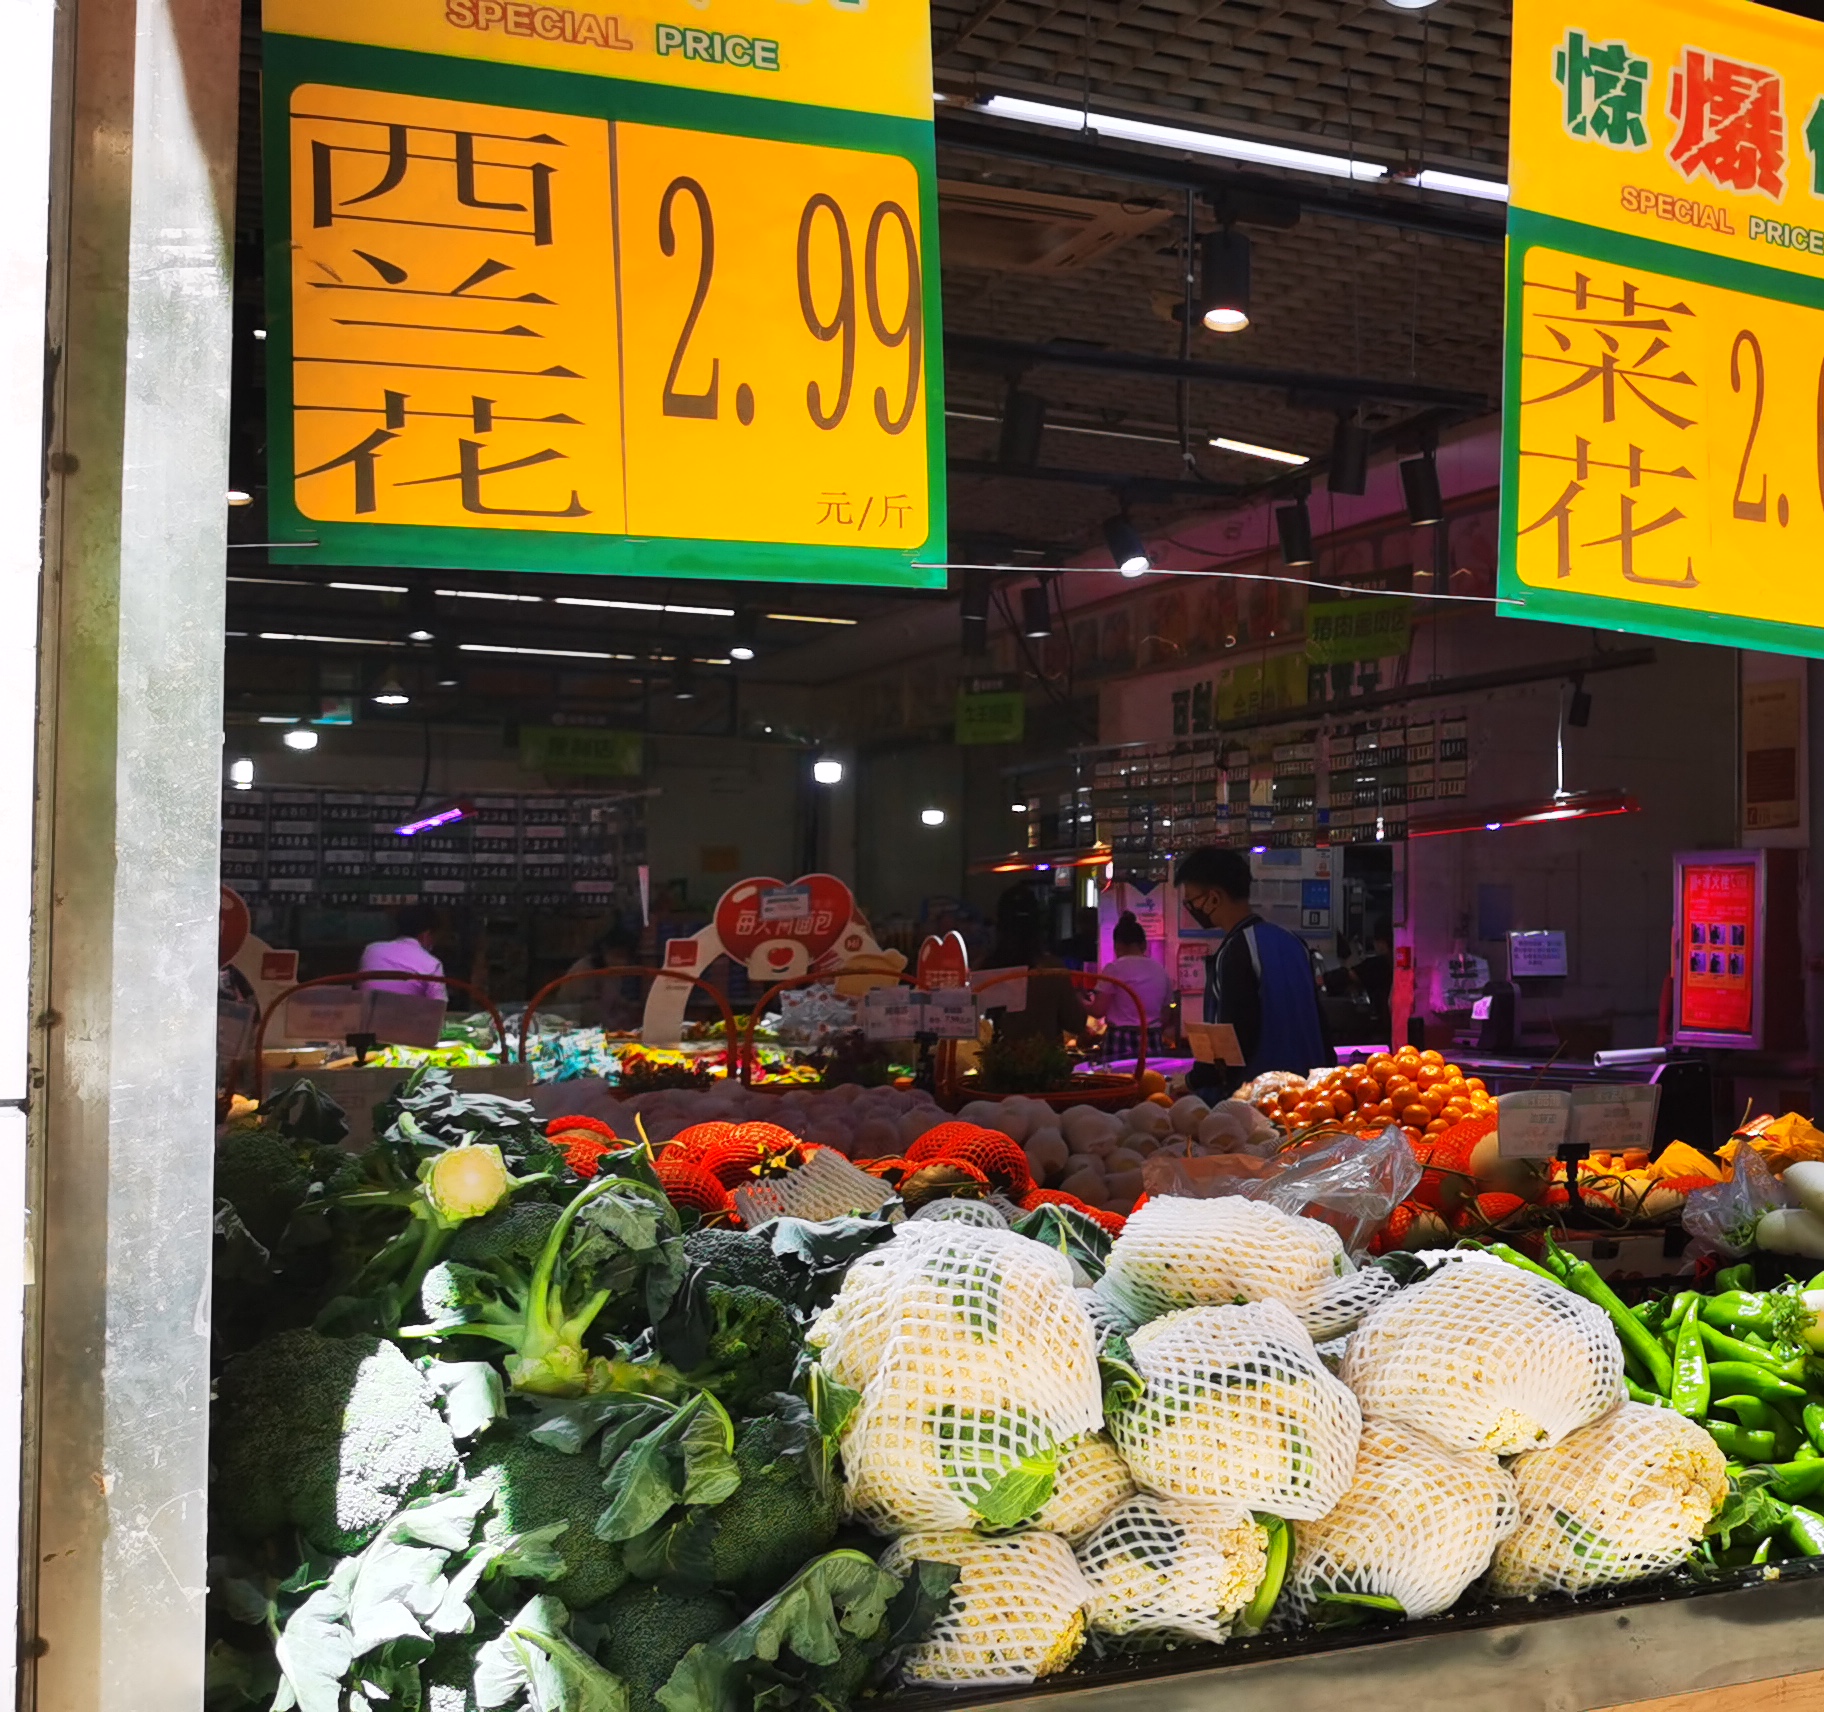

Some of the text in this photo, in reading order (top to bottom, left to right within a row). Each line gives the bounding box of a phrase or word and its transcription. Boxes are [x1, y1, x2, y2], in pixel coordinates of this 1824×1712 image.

[445, 0, 781, 71] SPECIAL PRICE
[1621, 185, 1735, 236] SPECIAL
[292, 112, 593, 518] 西兰花
[658, 175, 922, 436] 2.99
[815, 490, 914, 532] 元/斤
[1517, 270, 1700, 589] 菜花
